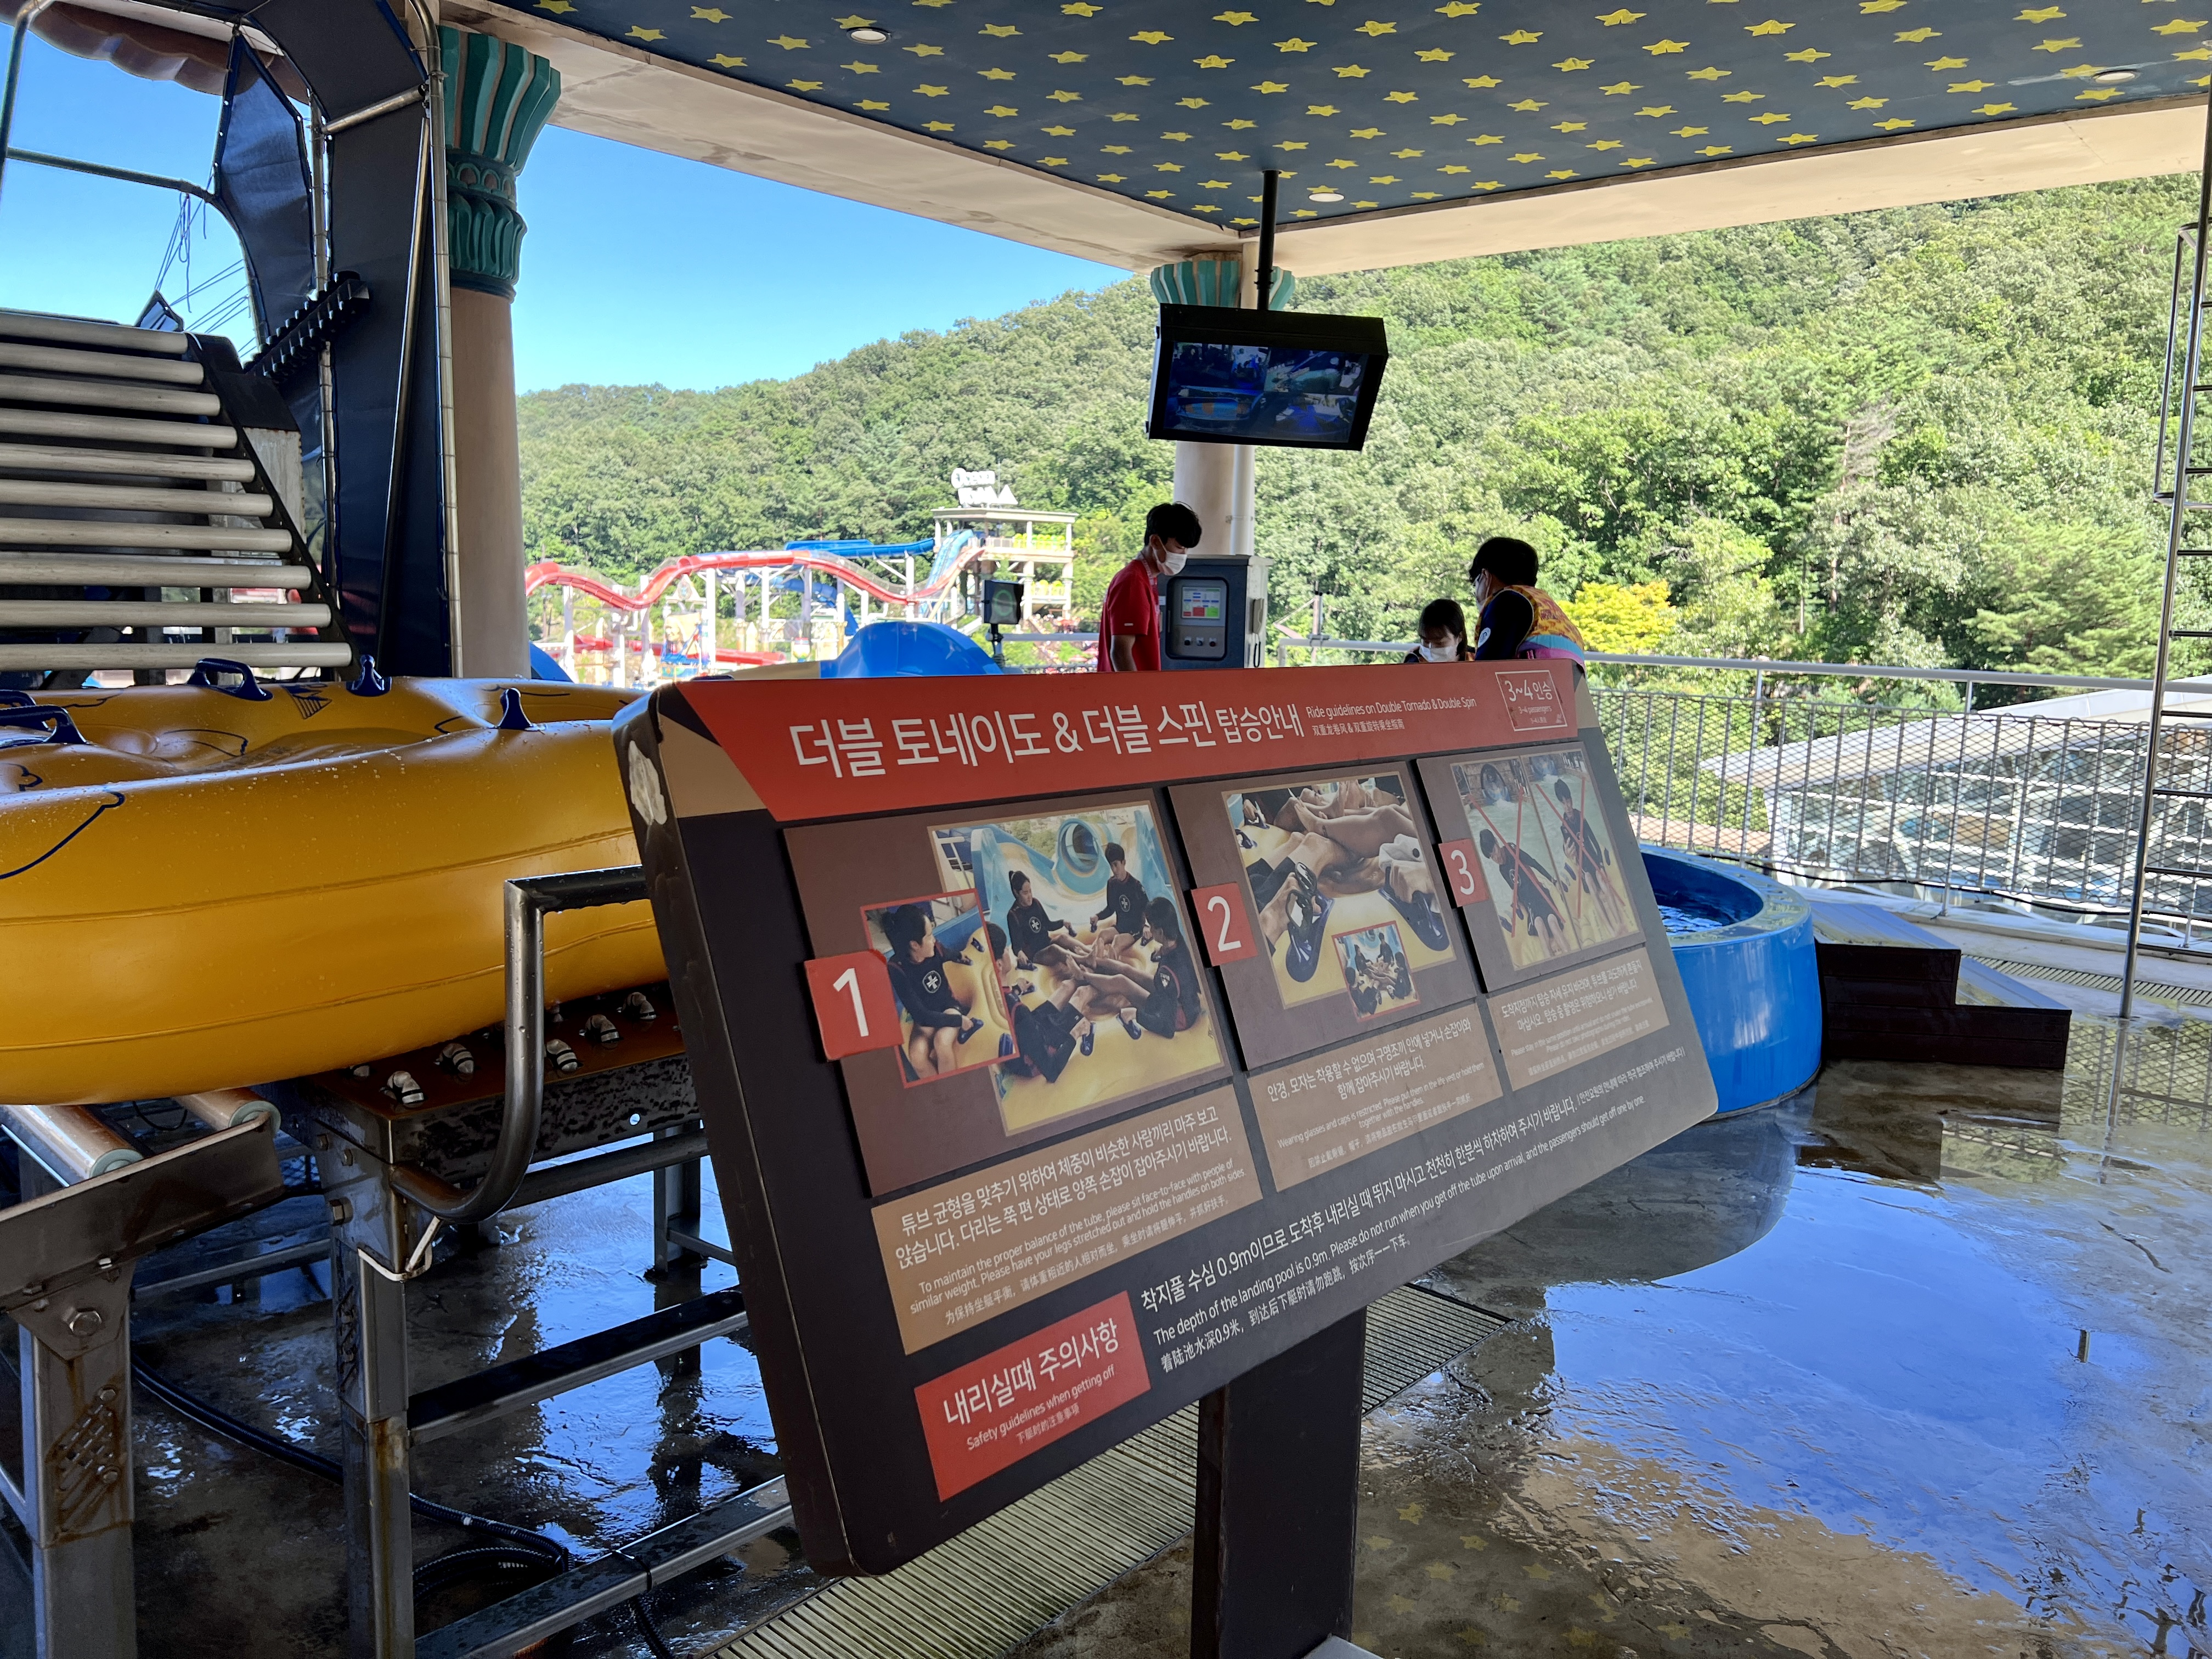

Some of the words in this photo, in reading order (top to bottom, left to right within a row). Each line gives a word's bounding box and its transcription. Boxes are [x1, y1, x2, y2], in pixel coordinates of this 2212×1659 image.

[789, 718, 886, 778] 더블
[891, 710, 1051, 767] 토네이도
[1052, 712, 1084, 753] &
[1082, 704, 1152, 754] 더블
[1157, 701, 1217, 747] 스핀
[1215, 703, 1305, 743] 탑승안내
[1305, 706, 1326, 718] Ride
[1325, 703, 1365, 720] guidelines
[1365, 705, 1376, 714] on
[1375, 701, 1403, 714] Double
[1401, 699, 1432, 712] Tornado
[1431, 698, 1438, 710] &
[1436, 697, 1462, 709] Double
[1460, 697, 1477, 710] Spin
[1451, 849, 1475, 896] 3
[1206, 895, 1243, 952] 2
[832, 967, 870, 1037] 1
[1267, 1080, 1290, 1102] 안경,
[1289, 1073, 1317, 1093] 모자는
[1316, 1062, 1343, 1084] 착용할
[1342, 1059, 1352, 1075] 수
[1351, 1049, 1377, 1073] 없으며
[1375, 1040, 1407, 1063] 구명조끼
[1406, 1034, 1423, 1053] 안에
[1421, 1026, 1444, 1047] 넣거나
[1444, 1017, 1472, 1040] 손잡이와
[1336, 1079, 1356, 1100] 함께
[1354, 1065, 1395, 1094] 잡아주시기
[1393, 1054, 1426, 1077] 바랍니다.
[895, 1228, 960, 1269] 앉습니다.
[960, 1214, 1002, 1242] 다리는
[1003, 1205, 1018, 1226] 쭉
[1018, 1198, 1034, 1222] 편
[1035, 1185, 1073, 1216] 상태로
[1072, 1175, 1098, 1201] 양쪽
[1099, 1160, 1134, 1192] 손잡이
[1133, 1141, 1188, 1177] 잡아주시기
[1187, 1125, 1232, 1154] 바랍니다.
[901, 1209, 933, 1237] 튜브
[933, 1192, 976, 1225] 균형을
[976, 1175, 1018, 1209] 맞추기
[1018, 1161, 1058, 1192] 위하여
[1057, 1148, 1095, 1176] 체중이
[1095, 1136, 1131, 1163] 비슷한
[1132, 1120, 1175, 1150] 사람끼리
[1173, 1113, 1197, 1134] 마주
[1197, 1106, 1219, 1126] 보고
[1141, 1275, 1186, 1312] 착지풀
[1188, 1260, 1216, 1292] 수심
[1217, 1228, 1289, 1277] 0.9m이므로
[1289, 1211, 1325, 1243] 도착후
[1324, 1194, 1361, 1225] 내리실
[1359, 1187, 1374, 1208] 때
[1372, 1177, 1396, 1204] 뛰지
[1394, 1165, 1427, 1192] 마시고
[1425, 1150, 1456, 1180] 천천히
[1454, 1137, 1485, 1166] 한분씩
[1482, 1121, 1519, 1151] 하차하여
[1517, 1110, 1544, 1136] 주시기
[1542, 1096, 1577, 1123] 바랍니다.
[910, 1293, 943, 1314] similar
[944, 1277, 980, 1300] weight.
[980, 1265, 1011, 1285] Please
[1011, 1256, 1033, 1272] have
[1034, 1246, 1053, 1265] your
[1054, 1239, 1073, 1254] legs
[1073, 1221, 1112, 1246] stretched
[1112, 1216, 1126, 1230] out
[1126, 1209, 1142, 1224] and
[1141, 1202, 1159, 1217] hold
[1159, 1198, 1172, 1210] the
[1172, 1187, 1200, 1205] handles
[1200, 1182, 1211, 1193] on
[1210, 1175, 1227, 1189] both
[918, 1281, 932, 1294] To
[933, 1264, 976, 1289] maintain
[976, 1258, 992, 1271] the
[993, 1244, 1023, 1267] proper
[1024, 1231, 1058, 1252] balance
[1059, 1224, 1068, 1238] of
[1068, 1221, 1084, 1234] the
[1084, 1213, 1105, 1228] tube,
[1105, 1201, 1131, 1223] please
[1131, 1196, 1142, 1209] sit
[1141, 1179, 1186, 1204] face-to-face
[1186, 1171, 1203, 1186] with
[1202, 1163, 1226, 1181] people
[1226, 1158, 1233, 1170] of
[1153, 1327, 1176, 1345] The
[1177, 1308, 1208, 1335] depth
[1209, 1300, 1220, 1318] of
[1220, 1295, 1238, 1312] the
[1238, 1277, 1275, 1304] landing
[1274, 1263, 1295, 1289] pool
[1295, 1261, 1305, 1275] is
[1304, 1251, 1330, 1270] 0.9m.
[1330, 1236, 1358, 1257] Please
[1358, 1229, 1370, 1244] do
[1370, 1221, 1385, 1238] not
[1384, 1216, 1399, 1231] run
[1398, 1205, 1420, 1223] when
[1419, 1198, 1435, 1216] you
[1434, 1190, 1448, 1209] get
[1447, 1183, 1458, 1199] off
[1458, 1180, 1470, 1193] the
[1470, 1172, 1487, 1187] tube
[1486, 1164, 1504, 1181] upon
[1503, 1152, 1526, 1171] arrival,
[1525, 1144, 1538, 1160] and
[1537, 1142, 1549, 1154] the
[1548, 1126, 1582, 1152] passengers
[1581, 1114, 1600, 1133] should
[1599, 1111, 1610, 1126] get
[1608, 1105, 1617, 1119] off
[1617, 1104, 1628, 1115] one
[1626, 1100, 1634, 1110] by
[1633, 1096, 1646, 1107] one.
[1039, 1317, 1119, 1381] 주의사항
[967, 1427, 998, 1451] Safety
[999, 1402, 1046, 1437] guidelines
[1046, 1390, 1071, 1410] when
[1071, 1374, 1103, 1400] getting
[1103, 1363, 1115, 1380] off
